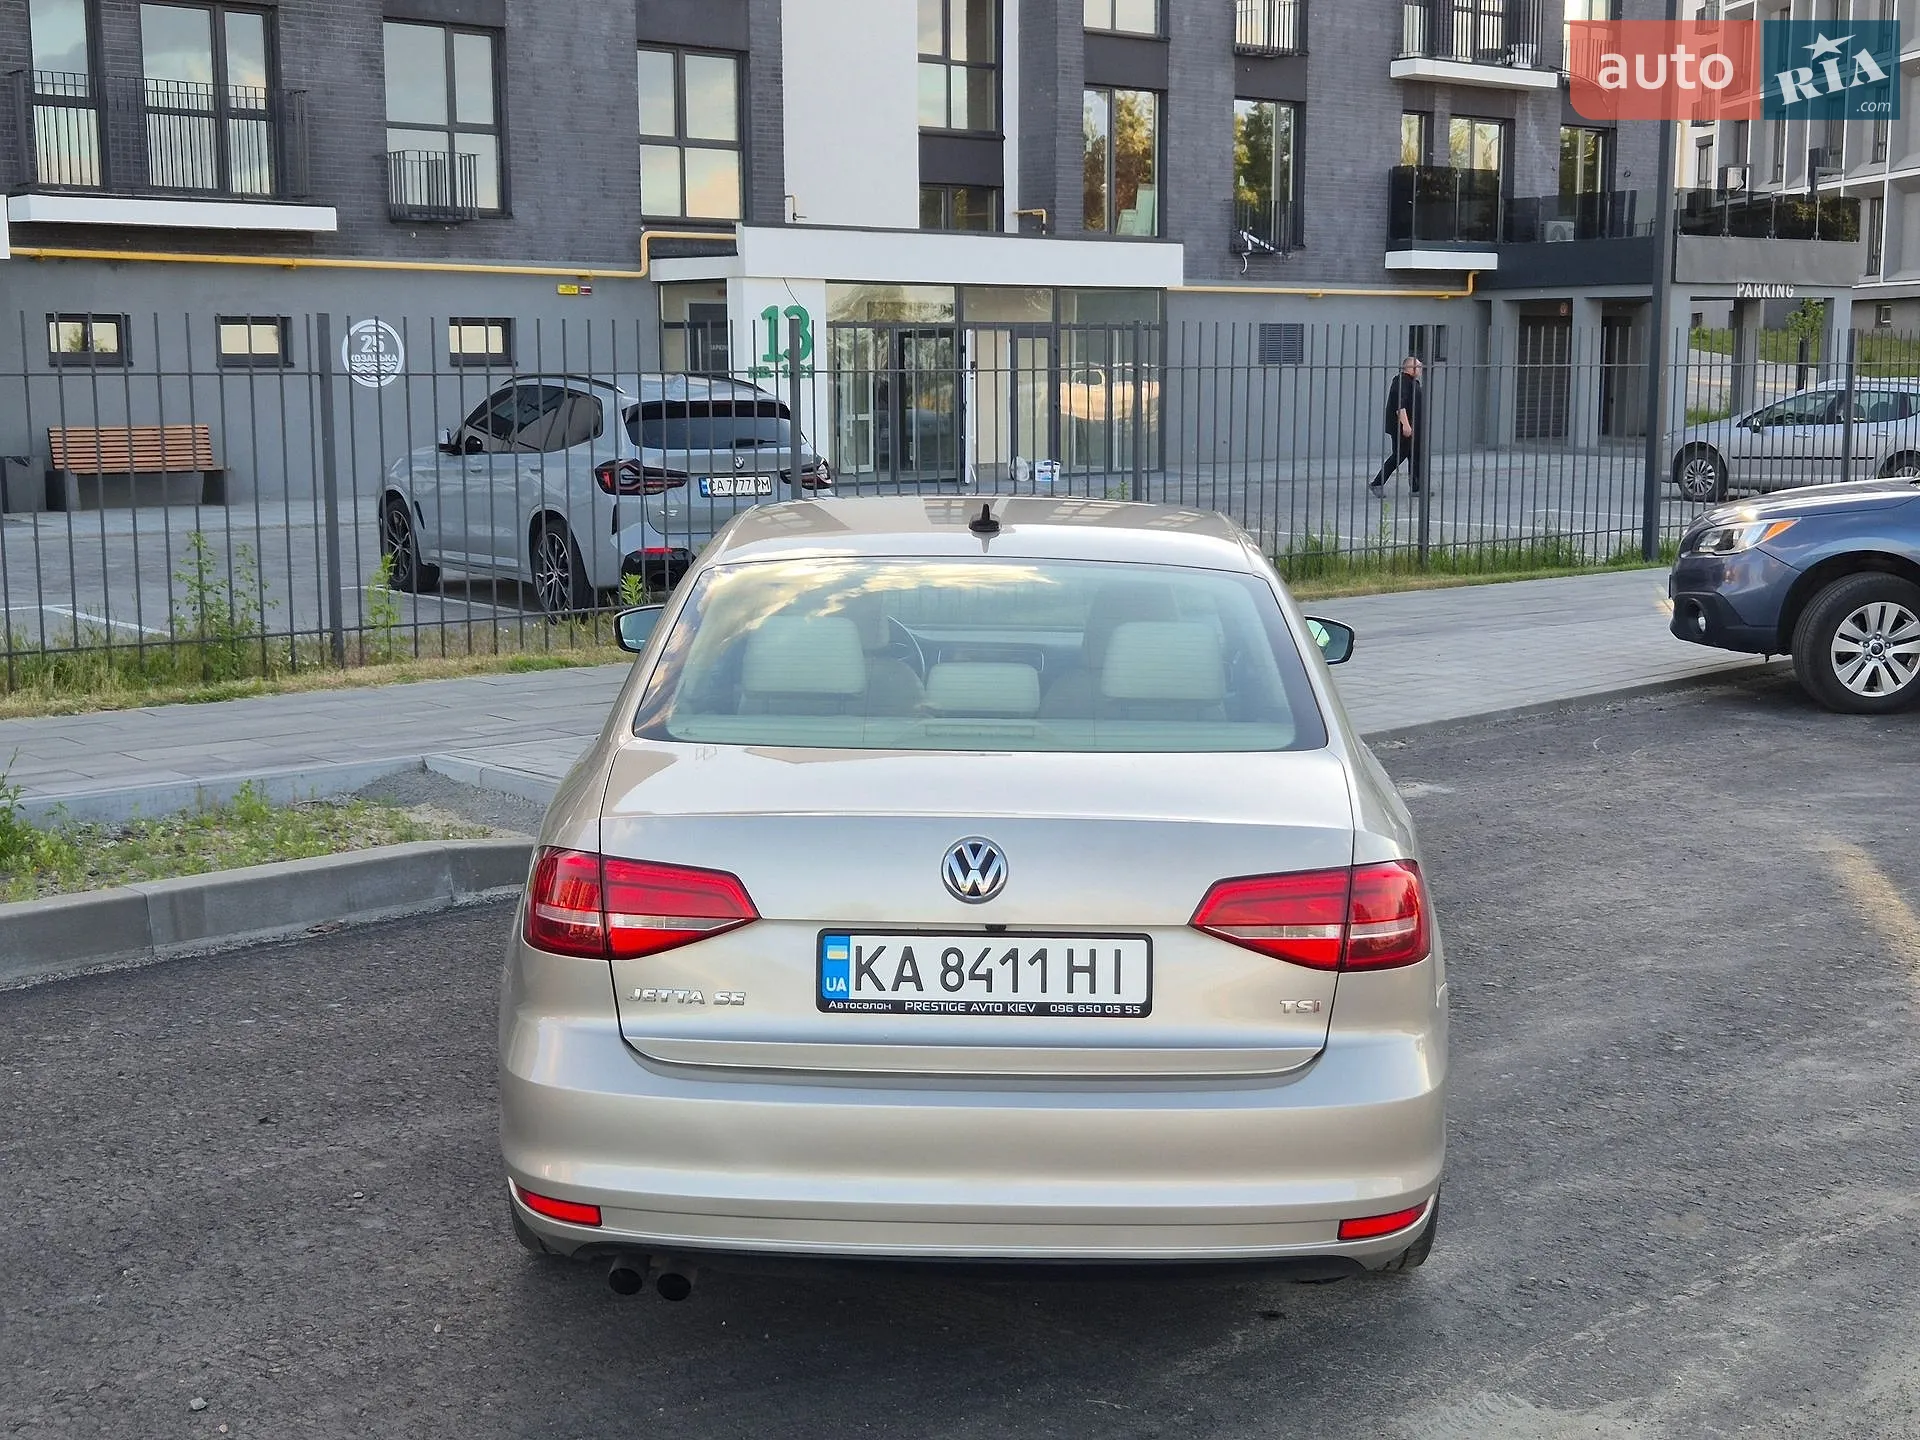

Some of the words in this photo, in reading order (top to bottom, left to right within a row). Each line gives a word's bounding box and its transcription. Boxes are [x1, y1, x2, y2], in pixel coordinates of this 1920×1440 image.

[1736, 283, 1794, 299] PARKING
[760, 305, 812, 362] 13
[360, 334, 385, 353] 25
[854, 945, 924, 992] KA
[939, 947, 1049, 995] 8411
[1066, 948, 1122, 995] HI
[825, 976, 848, 992] UA
[627, 988, 706, 1005] JETTA
[713, 991, 747, 1006] SE
[828, 1000, 892, 1010] Автосалон
[904, 1001, 966, 1012] PRESTIGE
[970, 1003, 1003, 1013] AVTO
[1007, 1003, 1036, 1013] KIEV
[1050, 1004, 1074, 1013] 096
[1077, 1004, 1101, 1013] 650
[1105, 1005, 1121, 1014] 05
[1124, 1005, 1142, 1014] 55
[1280, 1000, 1321, 1014] TSI
